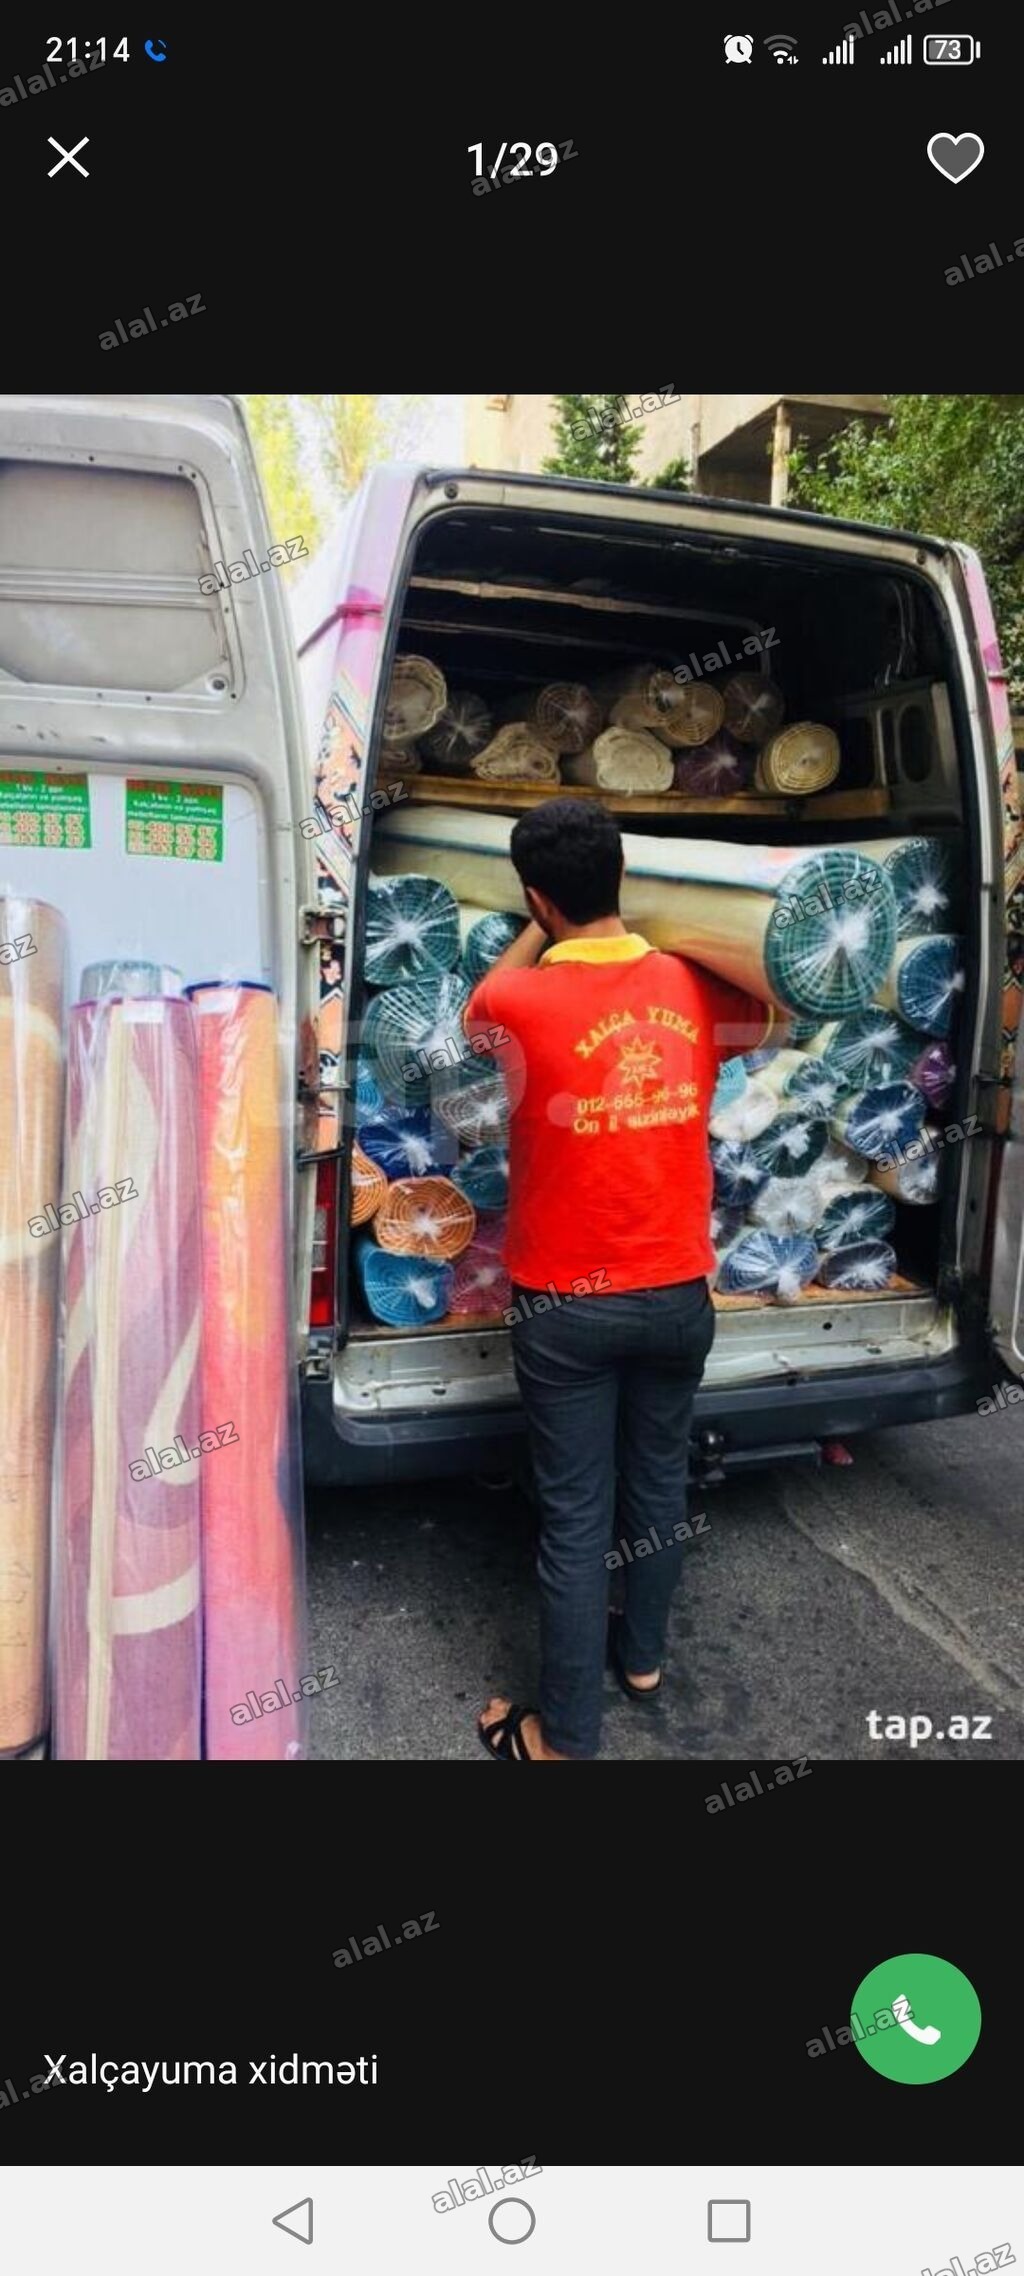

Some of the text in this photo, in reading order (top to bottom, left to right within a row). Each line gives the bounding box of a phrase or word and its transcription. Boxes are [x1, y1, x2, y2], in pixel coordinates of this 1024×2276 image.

[46, 37, 130, 62] 21:14
[935, 40, 961, 59] 73
[467, 142, 558, 179] 1/29
[646, 1005, 700, 1044] YUMA
[43, 2053, 378, 2093] Xalçayuma xidməti
